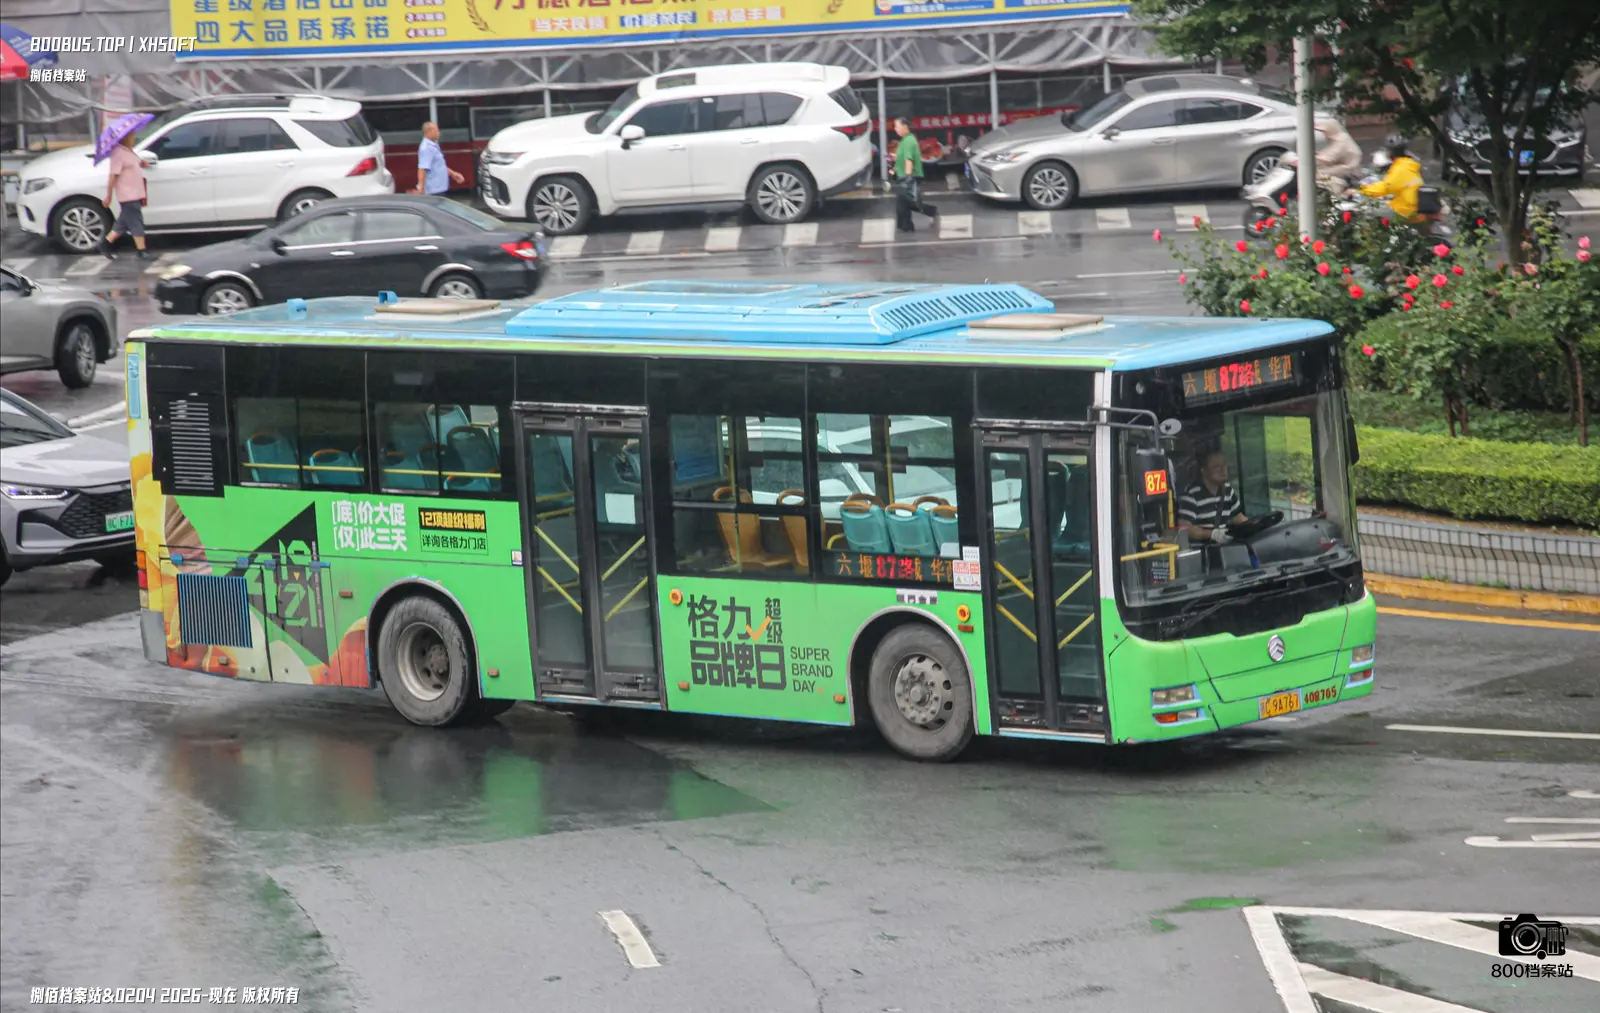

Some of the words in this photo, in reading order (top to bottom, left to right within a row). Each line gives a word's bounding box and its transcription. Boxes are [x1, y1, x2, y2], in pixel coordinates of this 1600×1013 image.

[195, 16, 390, 44] 四大品质承诺
[421, 533, 487, 551] 详询各格力门店
[687, 594, 752, 640] 格力
[765, 597, 783, 643] 超级
[690, 639, 787, 690] 品牌日
[790, 646, 831, 662] SUPER
[791, 662, 833, 678] BRAND
[793, 679, 816, 693] DAY
